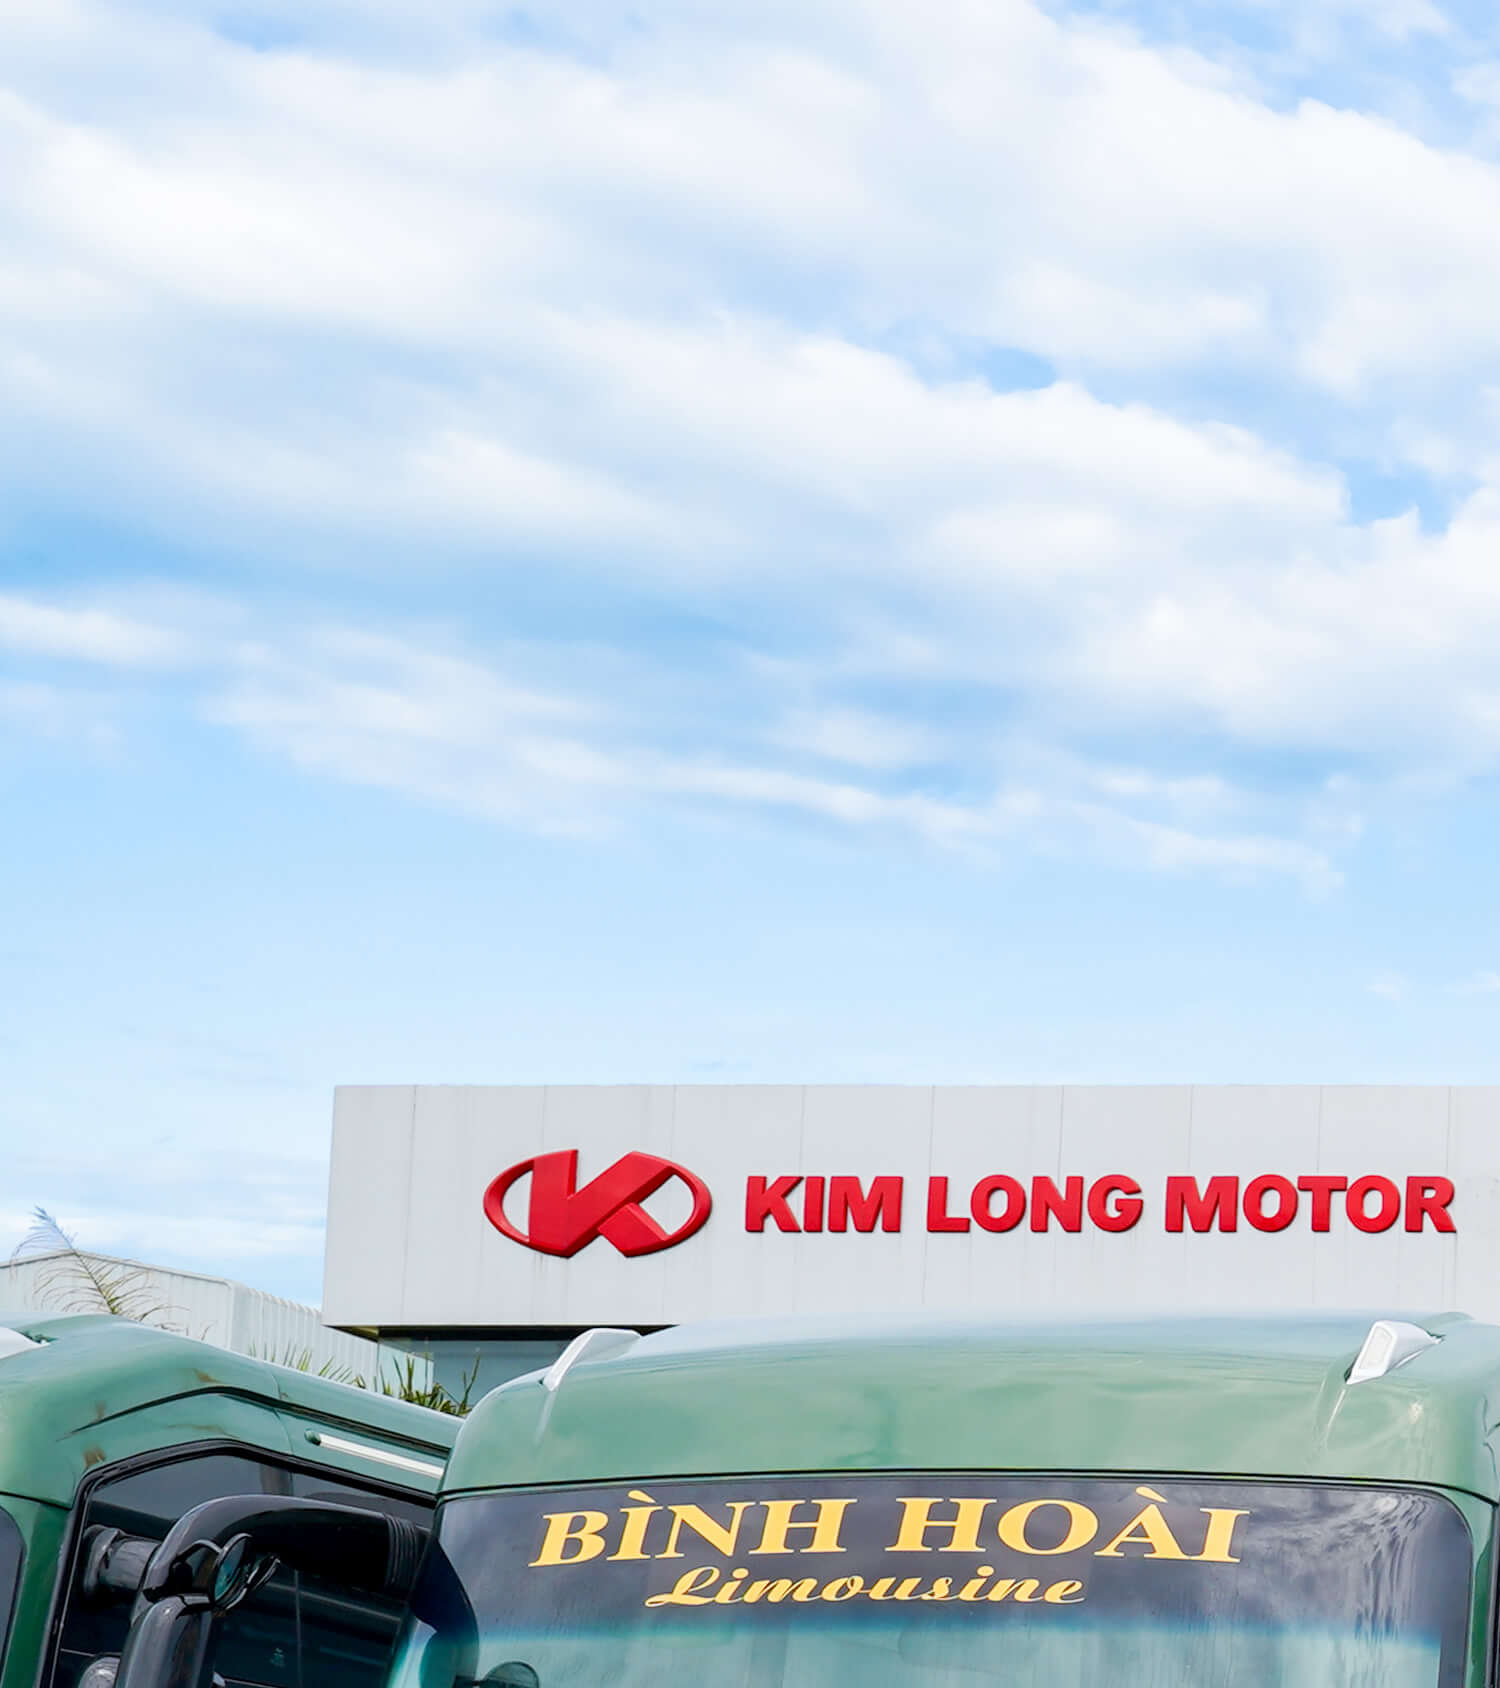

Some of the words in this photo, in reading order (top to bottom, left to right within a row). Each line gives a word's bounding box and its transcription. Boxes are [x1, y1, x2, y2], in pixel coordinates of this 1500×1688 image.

[745, 1175, 902, 1233] KIM
[926, 1175, 1143, 1233] LONG
[1164, 1175, 1457, 1233] MOTOR
[529, 1490, 857, 1567] BÌNH
[885, 1486, 1250, 1564] HOÀI
[645, 1564, 1085, 1608] Limousine
